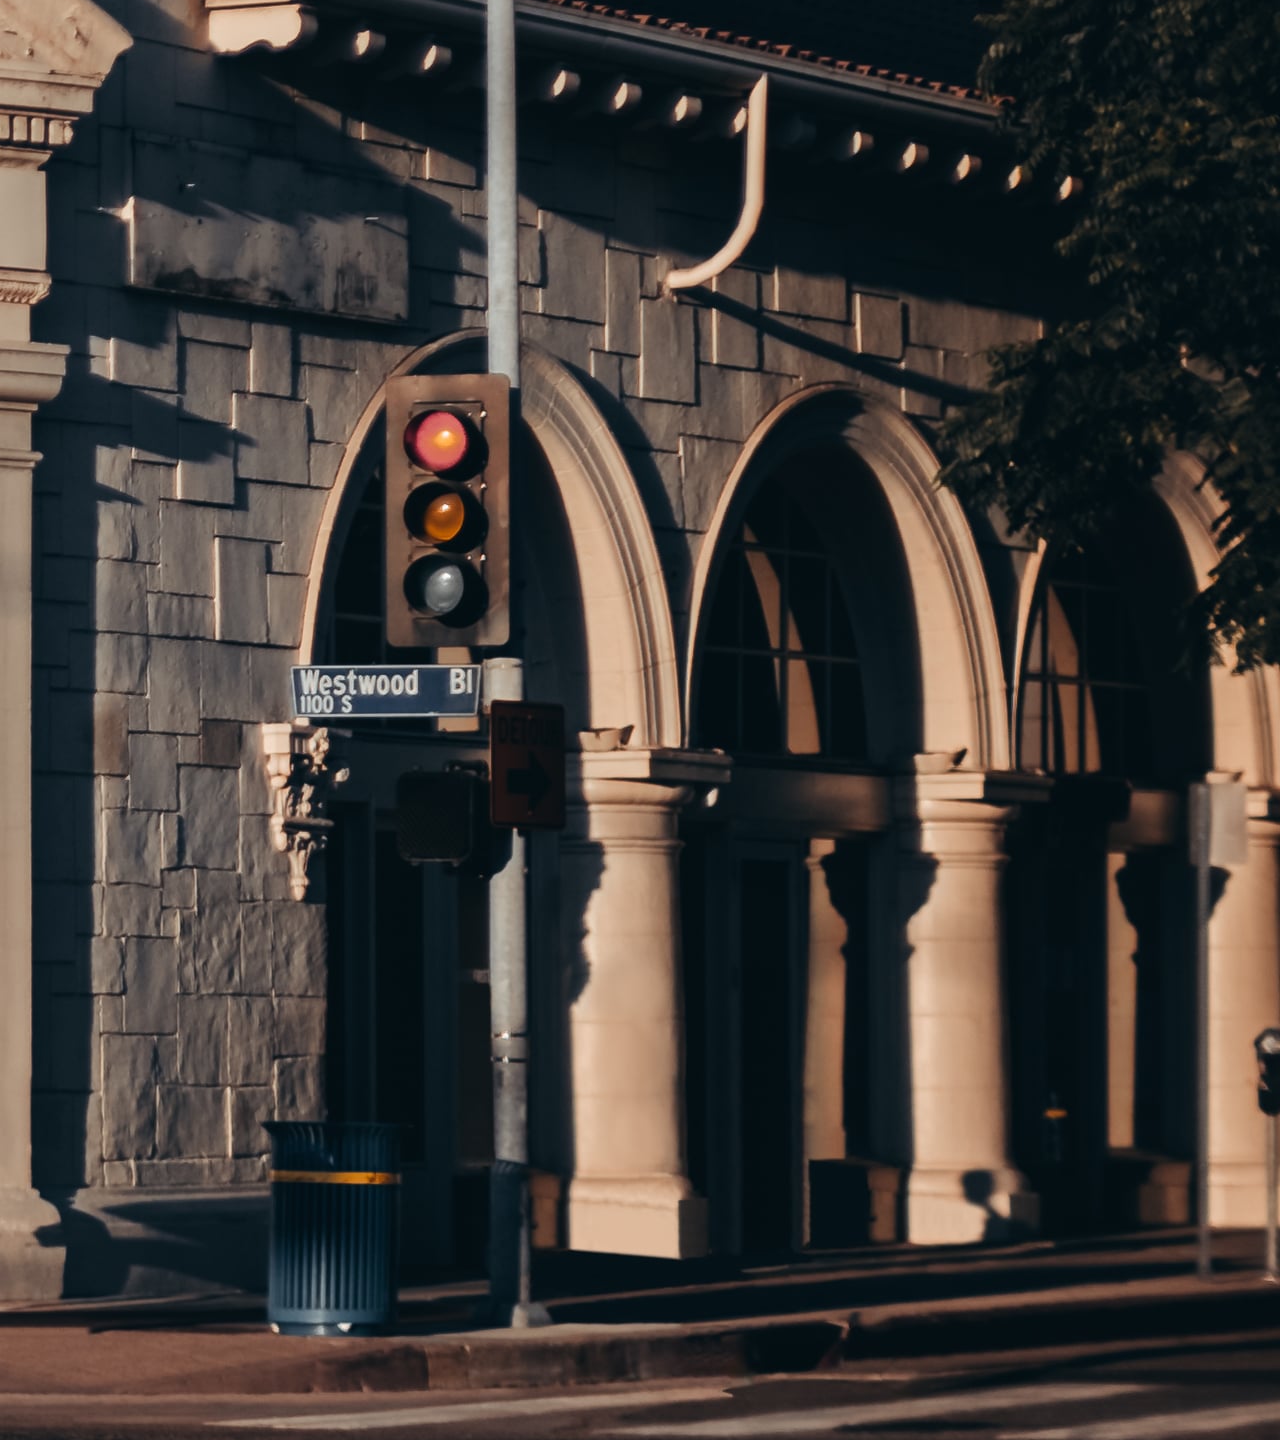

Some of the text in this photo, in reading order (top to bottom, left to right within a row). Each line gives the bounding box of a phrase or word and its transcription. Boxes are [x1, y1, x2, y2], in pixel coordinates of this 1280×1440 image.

[300, 668, 473, 695] Westwood Bl
[300, 695, 353, 713] 1100 S
